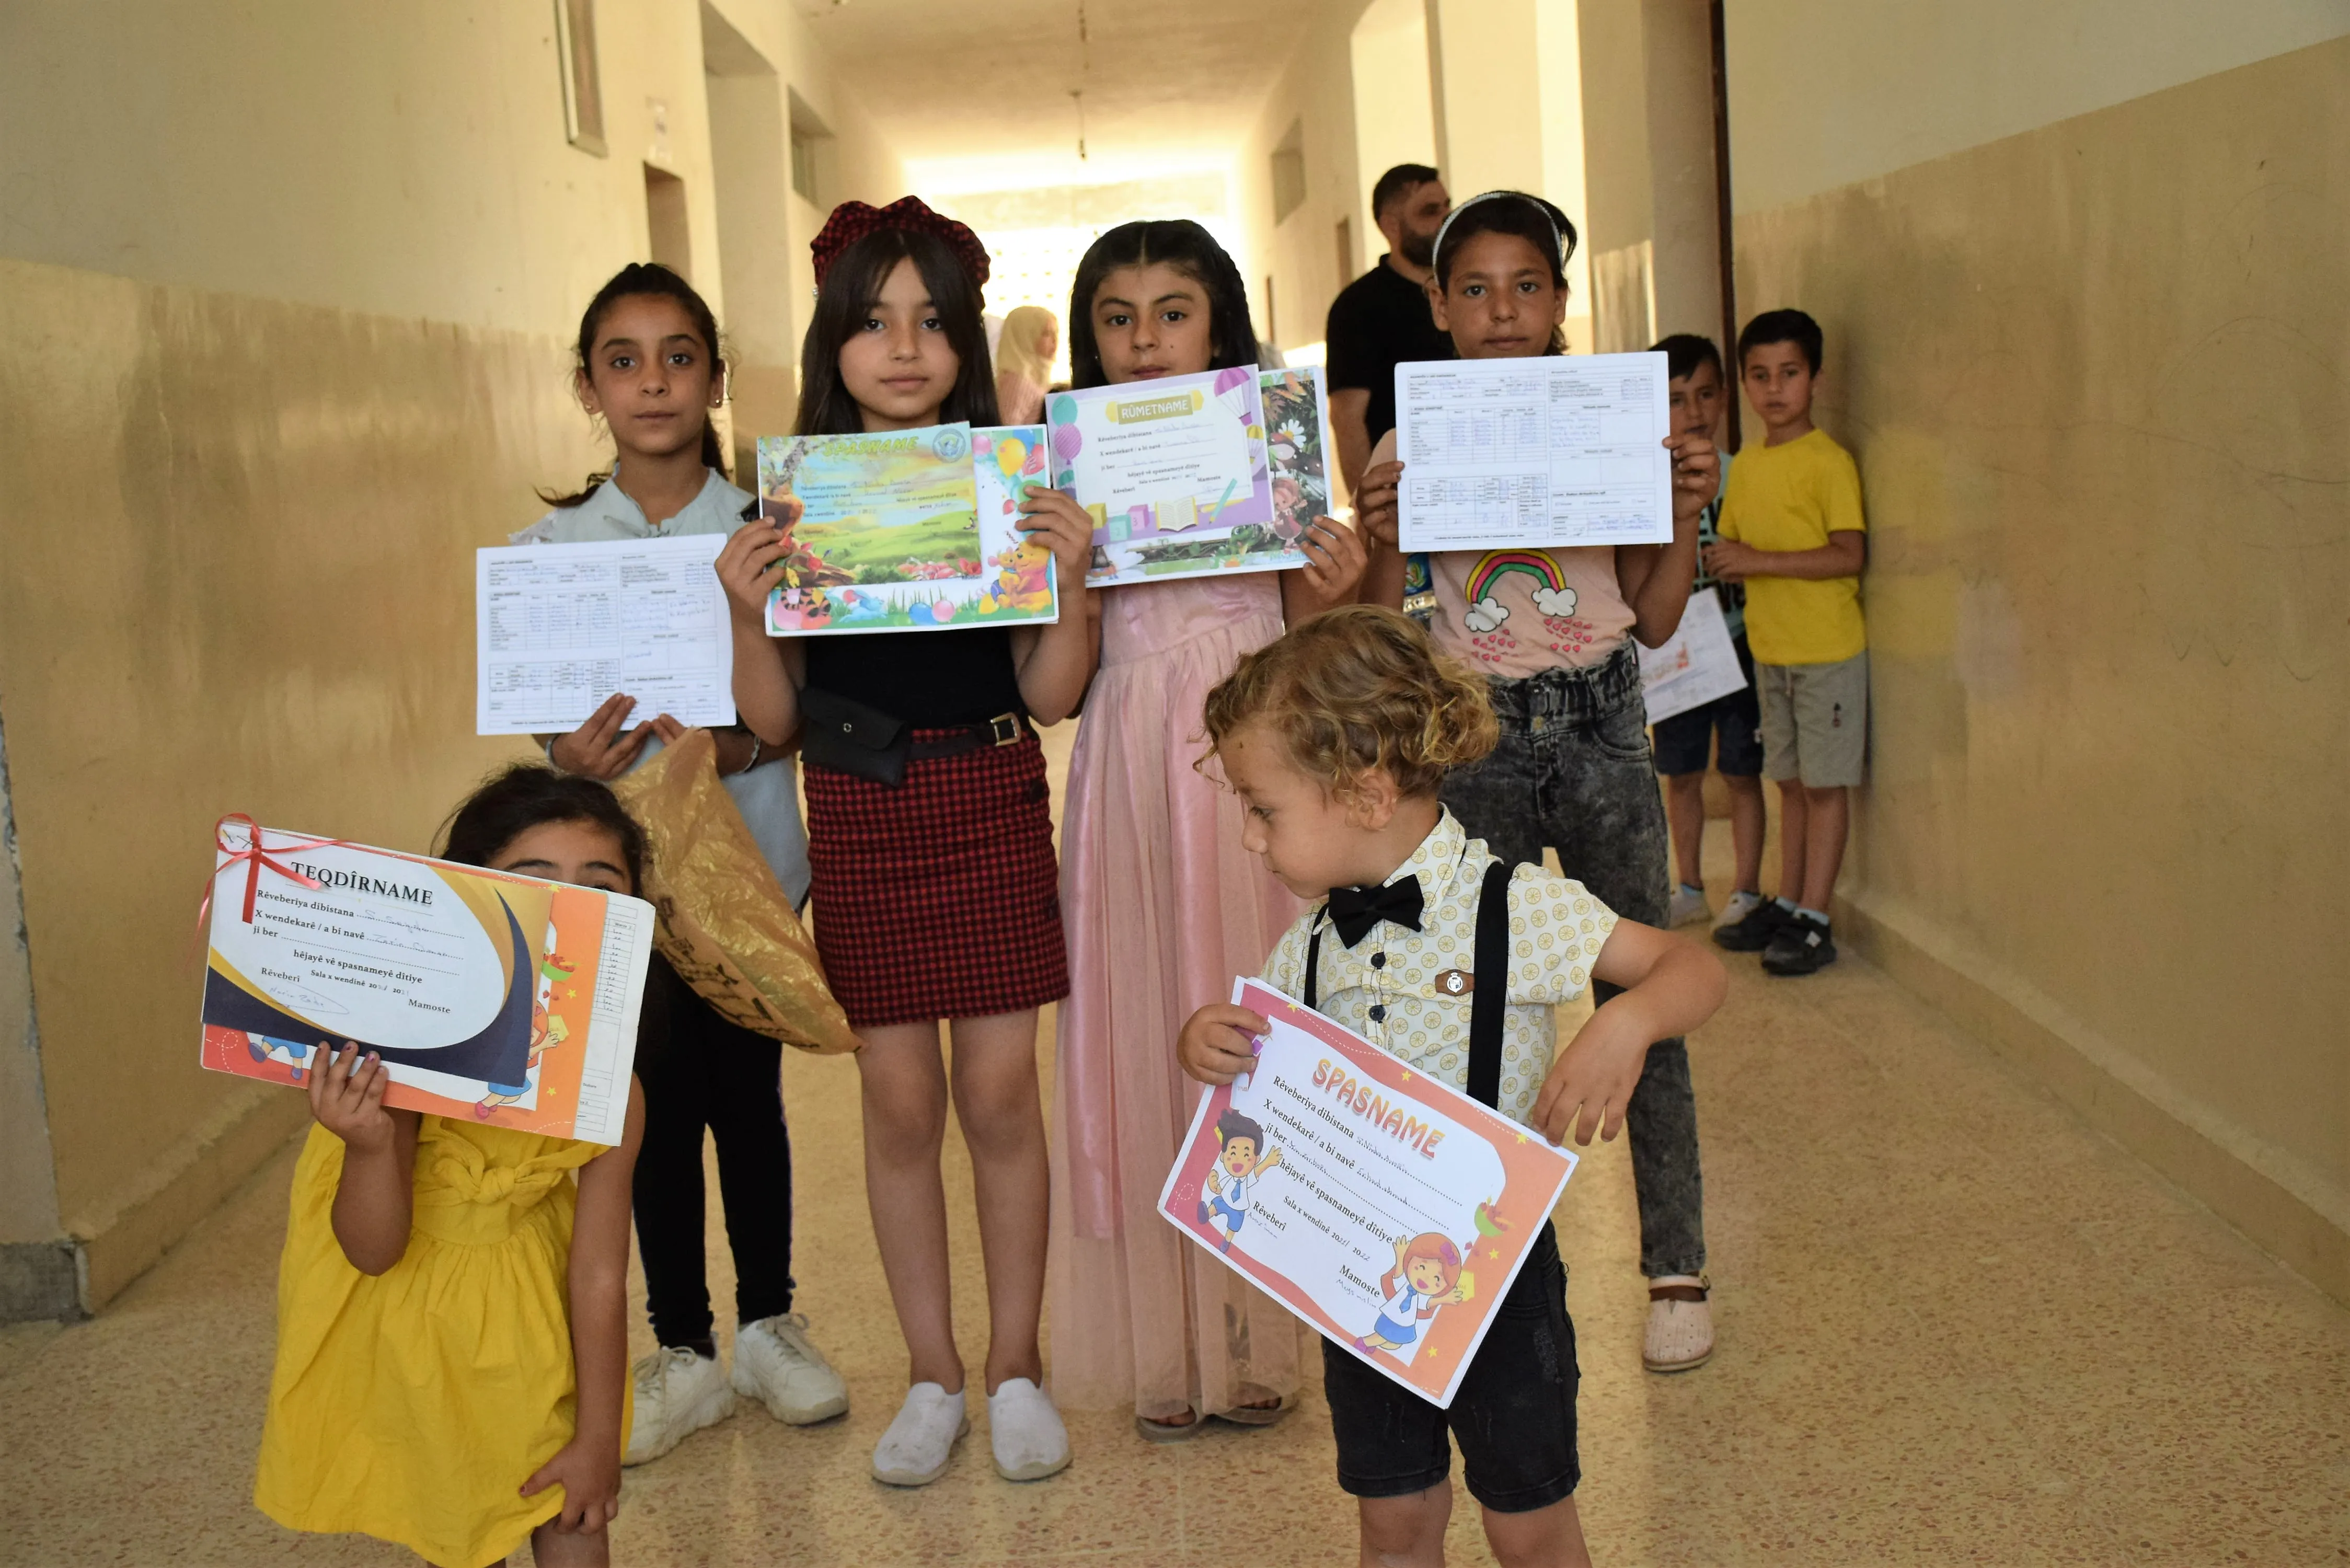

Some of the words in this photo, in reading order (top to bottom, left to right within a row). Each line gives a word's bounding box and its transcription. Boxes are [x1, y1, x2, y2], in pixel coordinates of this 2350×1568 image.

[1121, 399, 1189, 419] RÛMETNAME
[823, 436, 919, 457] SPASNAME
[291, 861, 433, 905] TEQDÎRNAME
[257, 890, 308, 908] Rêveberiya
[311, 902, 354, 917] dibistana
[253, 925, 260, 935] ji
[262, 927, 279, 938] ber
[265, 914, 316, 930] wendekarê
[332, 925, 341, 935] bi
[343, 929, 365, 940] navê
[261, 967, 301, 983] Rêveberî
[294, 949, 324, 964] hêjayê
[326, 955, 336, 965] vê
[338, 961, 394, 978] spasnameyê
[396, 971, 423, 984] dîtiye
[310, 969, 326, 979] Sala
[334, 975, 366, 987] wendinê
[408, 998, 452, 1014] Mamoste
[1273, 1076, 1316, 1113] Rêveberiya
[1317, 1106, 1354, 1139] dibistana
[1312, 1058, 1446, 1159] SPASNAME
[1263, 1099, 1272, 1110] X
[1273, 1106, 1314, 1140] wendekarê
[1314, 1135, 1320, 1144] /
[1326, 1142, 1336, 1156] bi
[1335, 1151, 1355, 1169] navê
[1264, 1123, 1273, 1134] ji
[1273, 1127, 1287, 1144] ber
[1253, 1201, 1287, 1231] Rêveberî
[1280, 1159, 1306, 1183] hêjayê
[1306, 1181, 1316, 1191] vê
[1315, 1187, 1366, 1226] spasnameyê
[1366, 1219, 1393, 1245] dîtiye
[1283, 1195, 1297, 1210] Sala
[1303, 1208, 1330, 1234] wendinê
[1339, 1264, 1380, 1298] Mamoste
